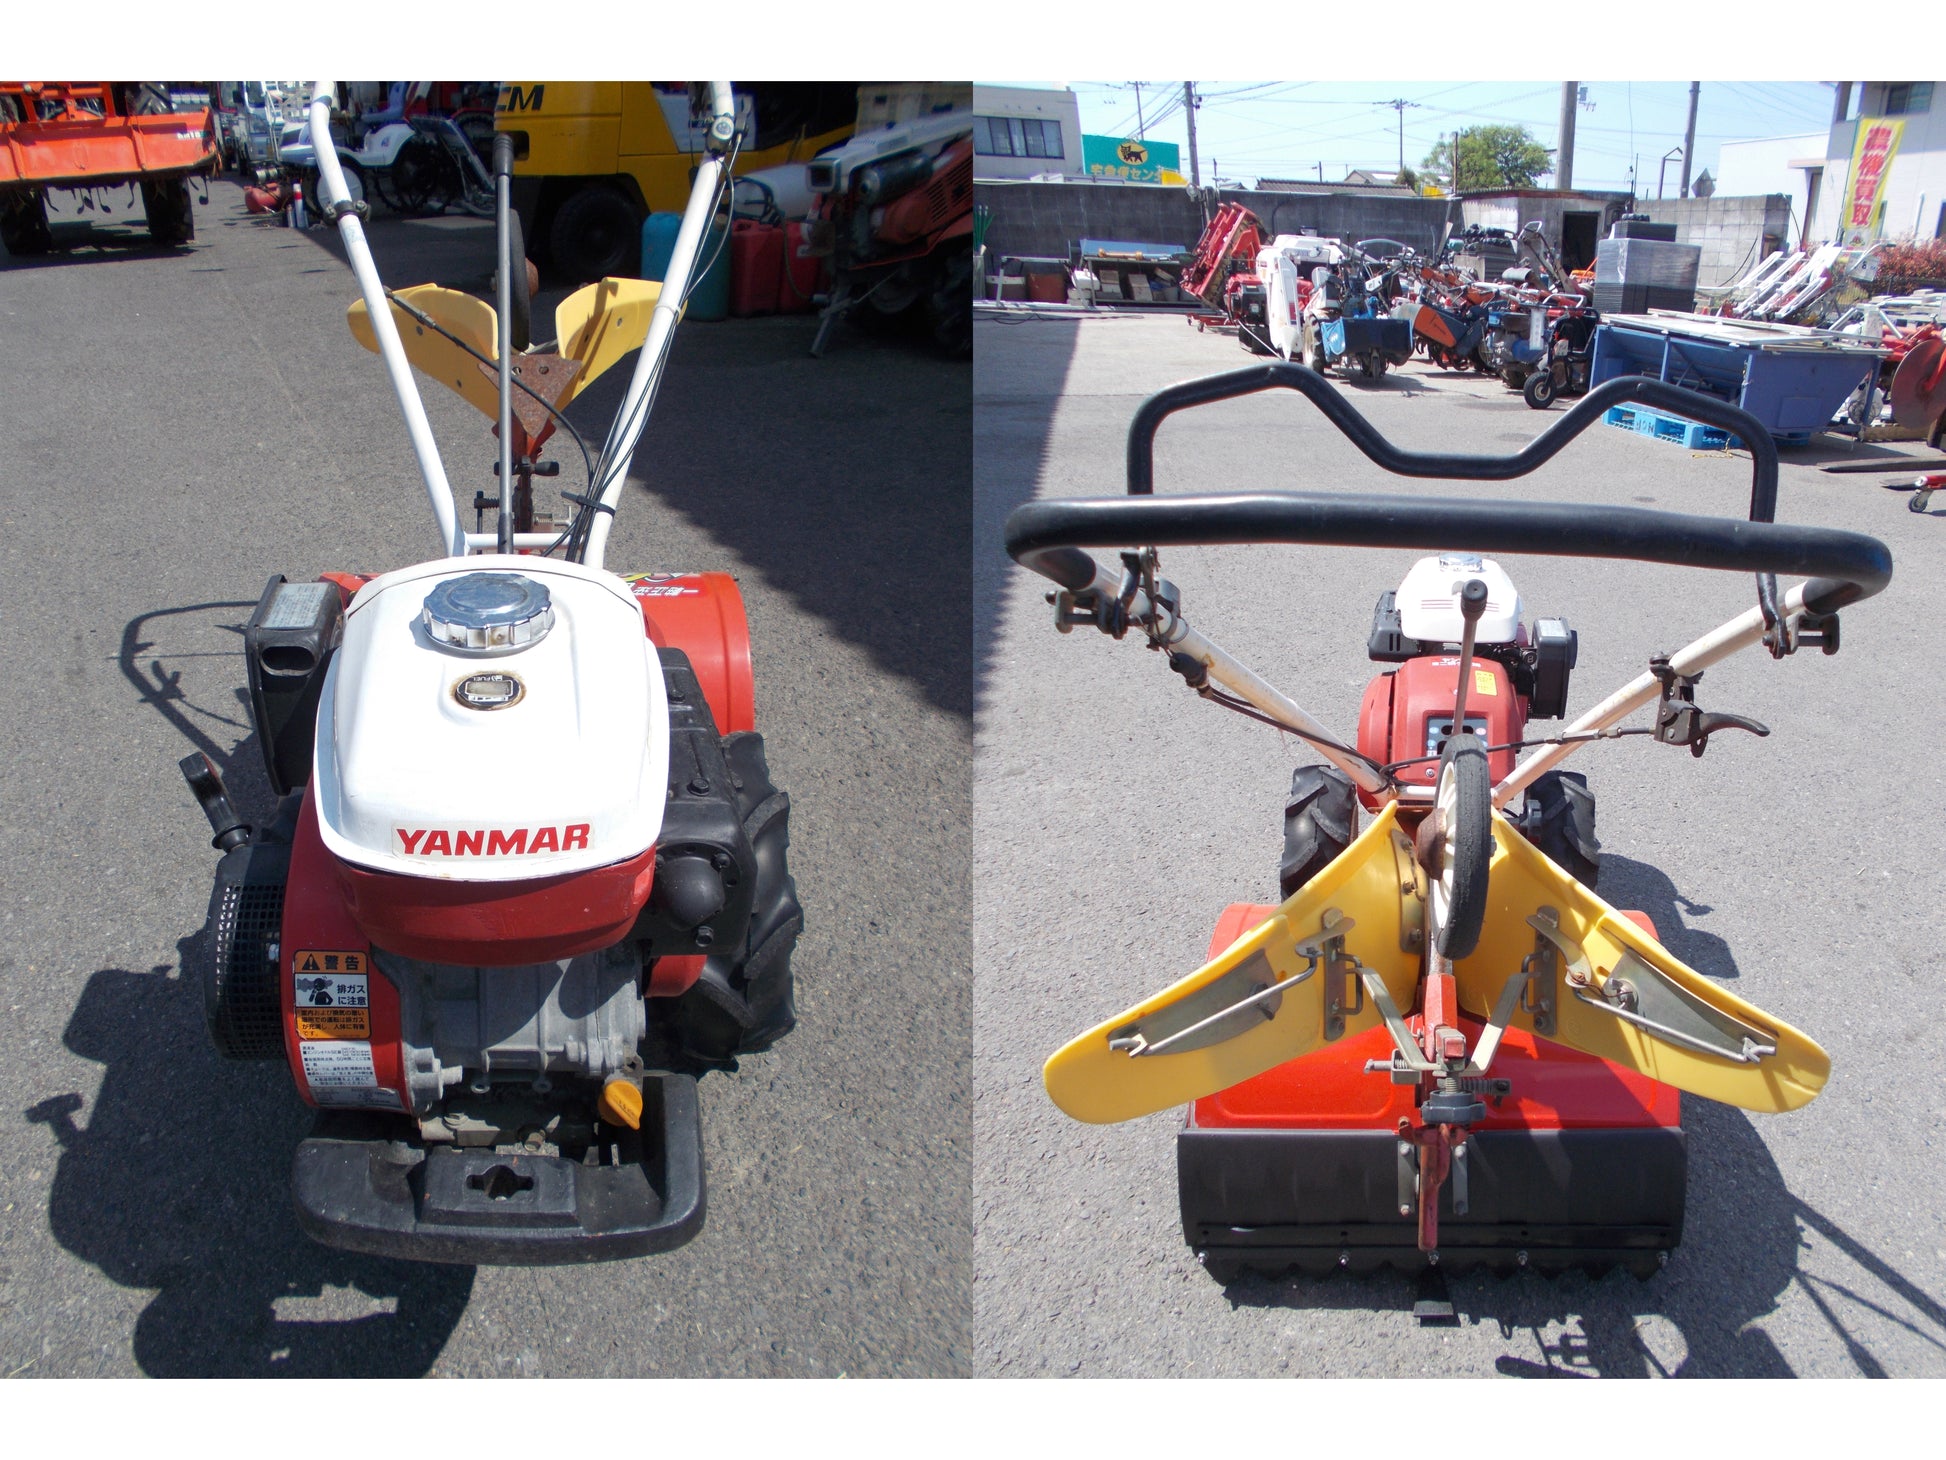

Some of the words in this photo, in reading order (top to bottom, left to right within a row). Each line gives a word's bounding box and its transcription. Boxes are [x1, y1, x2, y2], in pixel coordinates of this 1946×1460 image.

[396, 823, 591, 856] YANMAR
[325, 955, 359, 970] 警告
[337, 984, 366, 994] 排ガス
[338, 996, 367, 1006] に注意
